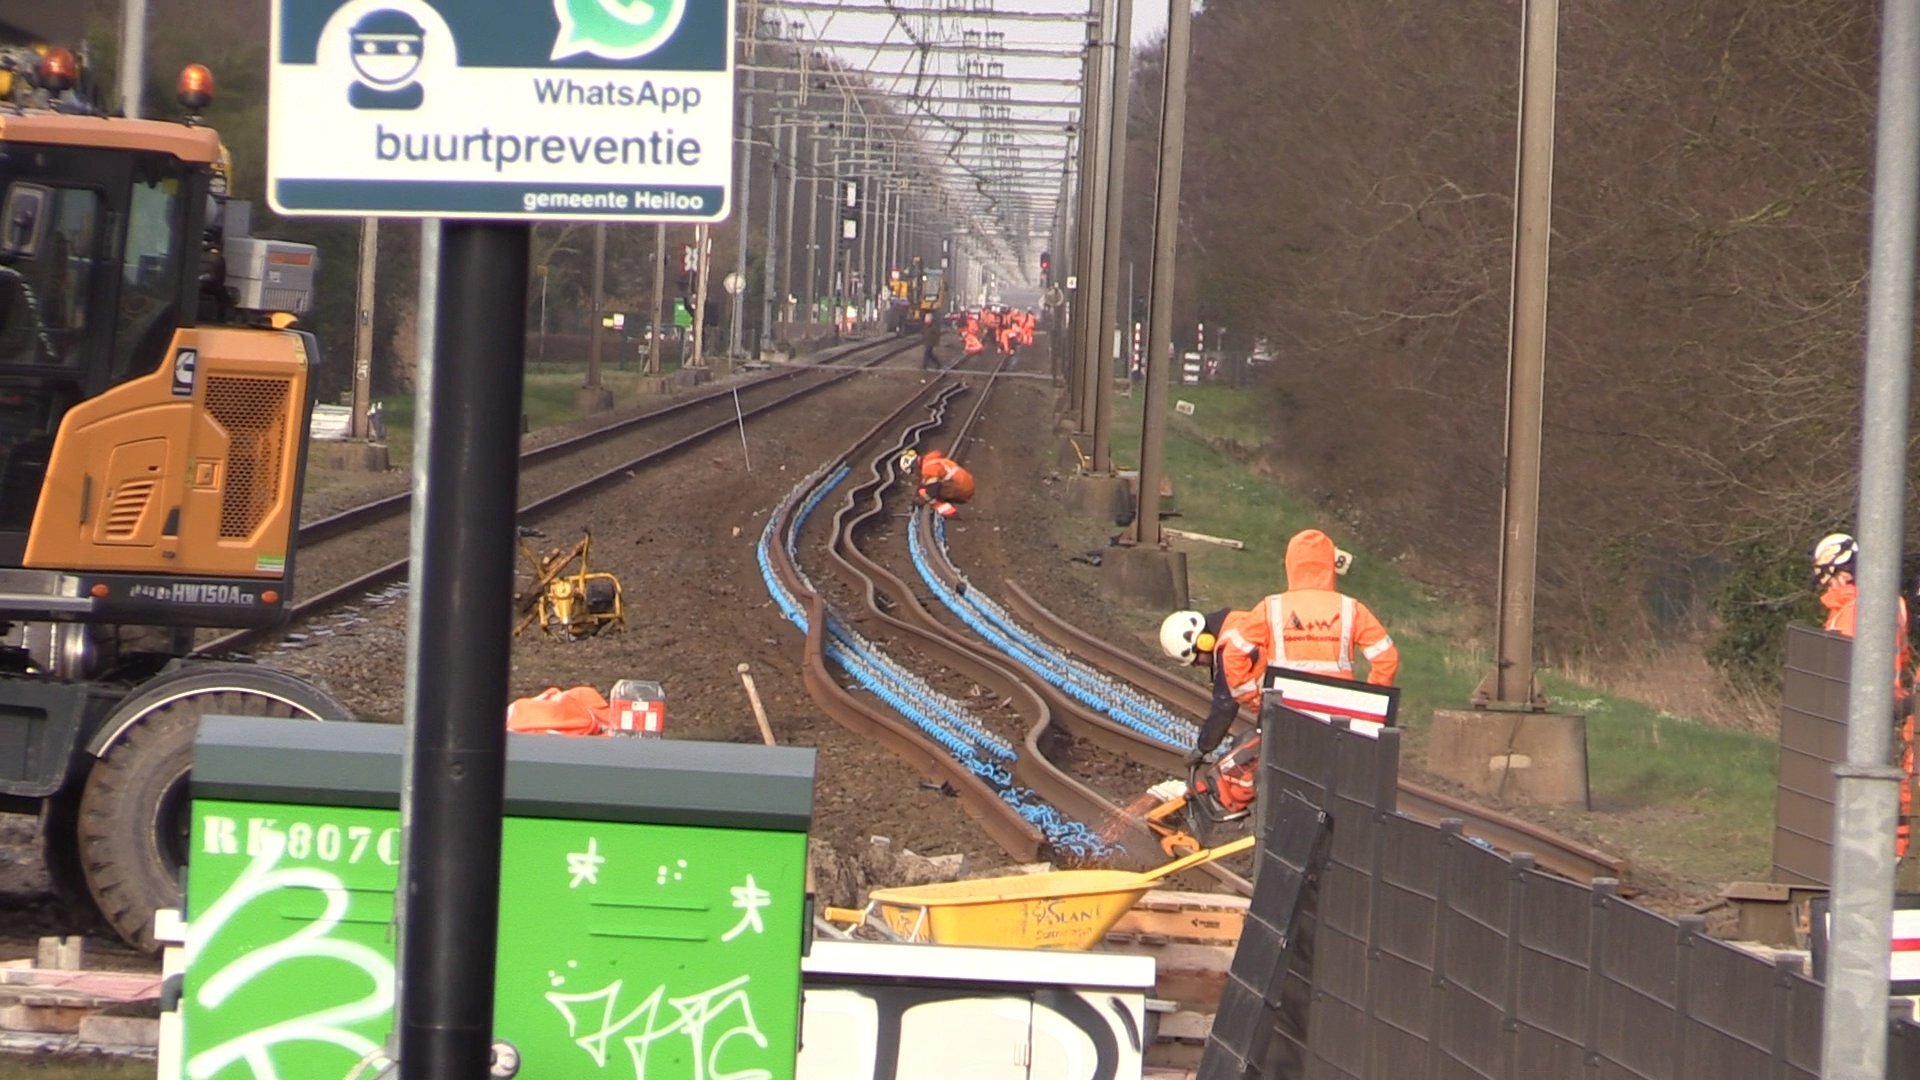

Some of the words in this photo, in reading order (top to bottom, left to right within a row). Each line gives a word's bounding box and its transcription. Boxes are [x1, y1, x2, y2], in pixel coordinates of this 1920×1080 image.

[533, 78, 702, 114] WhatsApp
[375, 123, 701, 172] buurtpreventie
[523, 192, 628, 211] gemeente
[634, 191, 704, 210] Heiloo
